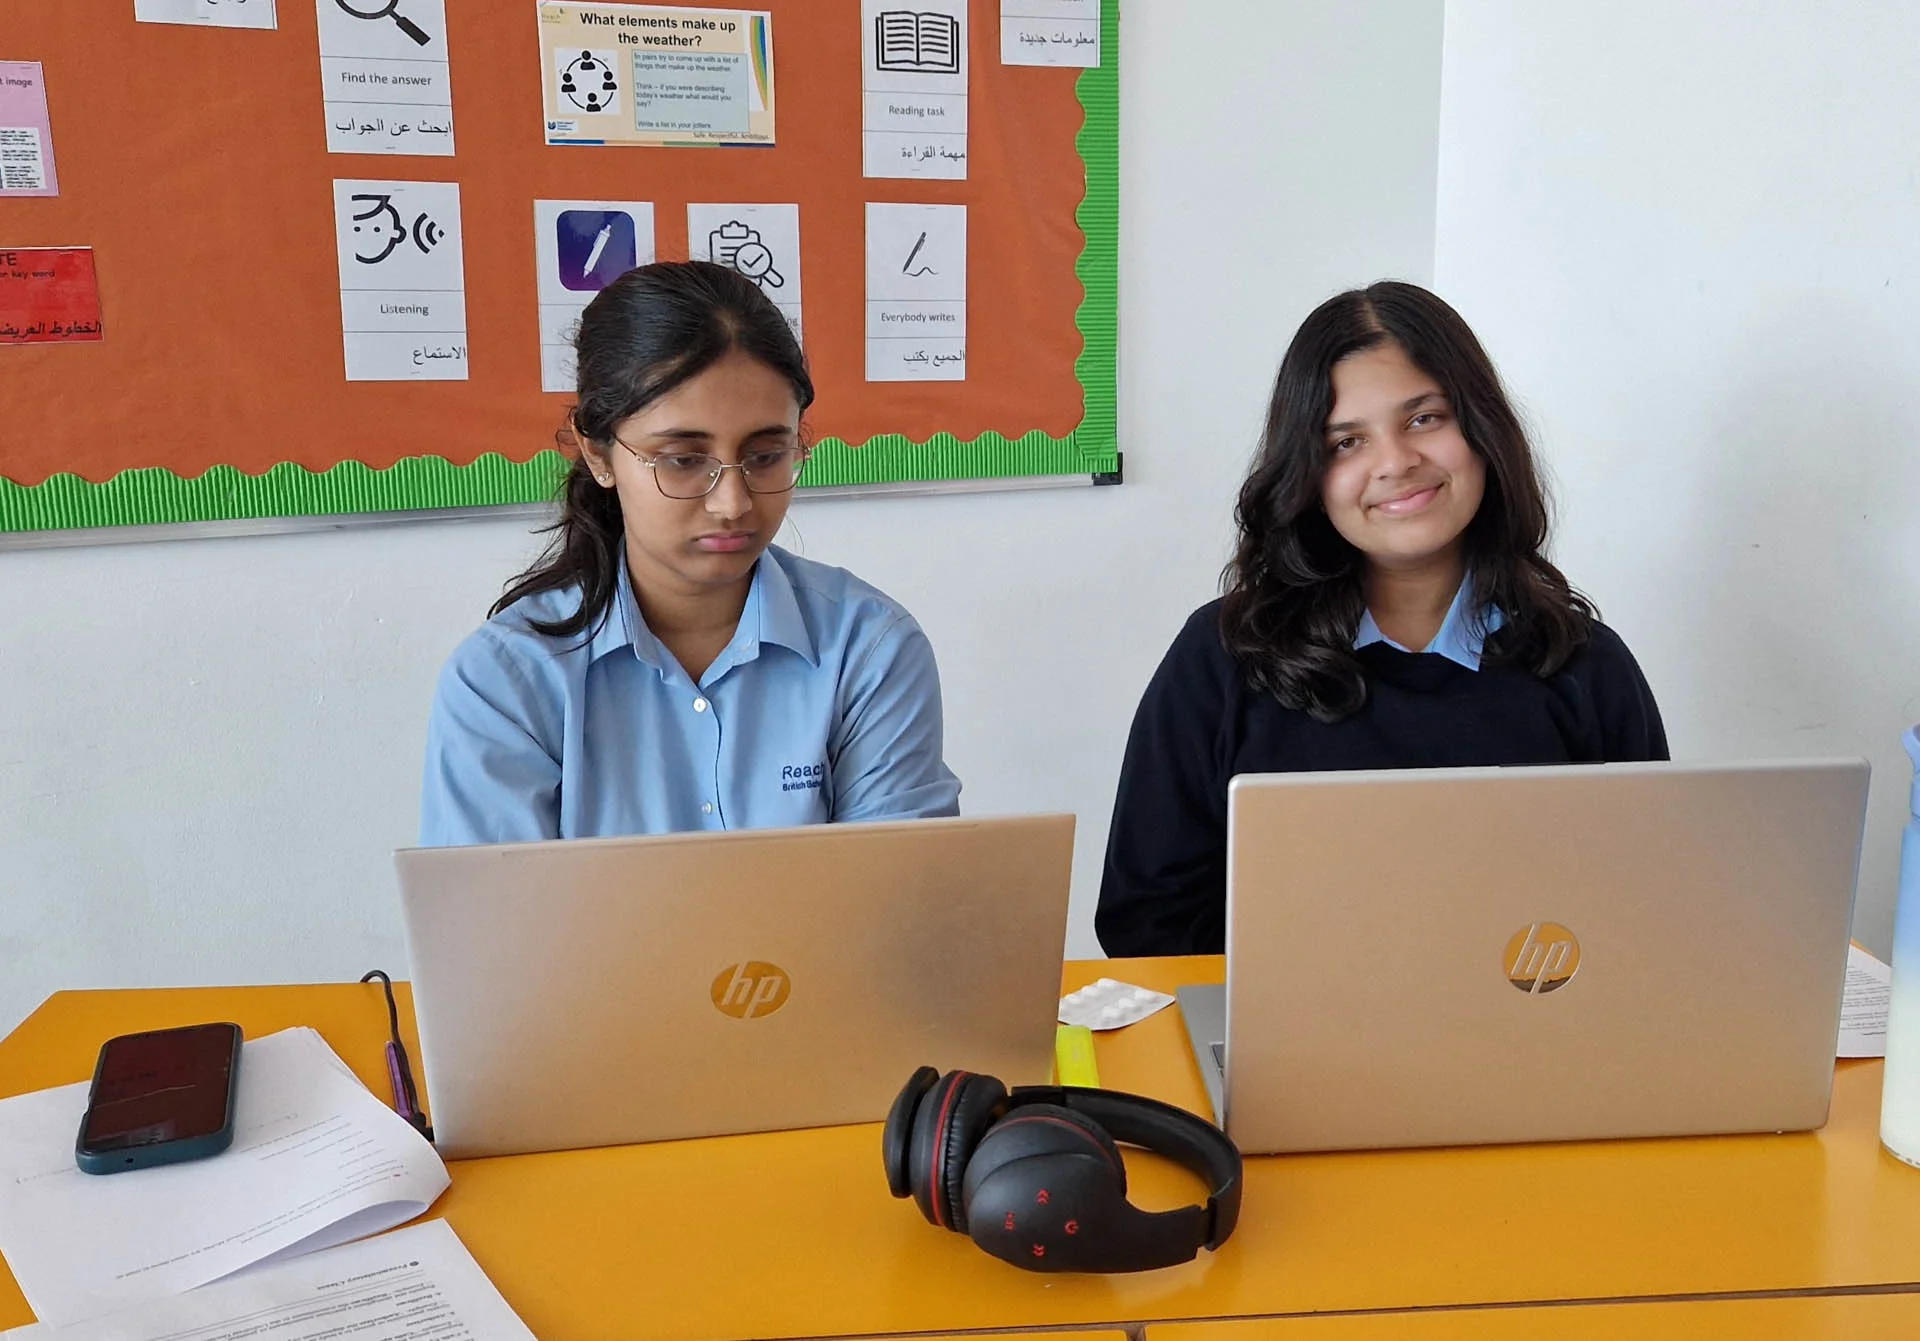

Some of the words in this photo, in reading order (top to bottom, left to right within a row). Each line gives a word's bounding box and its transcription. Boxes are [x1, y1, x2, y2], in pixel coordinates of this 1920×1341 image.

[580, 12, 614, 25] What
[618, 14, 678, 28] elements
[682, 18, 716, 31] make
[720, 21, 736, 34] up
[618, 32, 639, 44] the
[642, 34, 702, 47] weather?
[1019, 32, 1047, 46] جديدة
[1051, 31, 1095, 48] معلومات
[6, 77, 33, 88] image
[341, 72, 366, 84] Find
[369, 72, 388, 84] the
[391, 75, 432, 86] answer
[888, 104, 925, 118] Reading
[927, 106, 945, 116] task
[336, 117, 384, 136] الجواب
[390, 122, 411, 136] عن
[417, 119, 452, 136] ابحث
[901, 145, 936, 162] القراءة
[939, 145, 966, 162] مهمة
[380, 303, 429, 316] Listening
[881, 312, 927, 323] Everybody
[929, 312, 956, 321] writes
[49, 320, 102, 337] الخطوط
[412, 345, 467, 365] الاستماع
[903, 350, 930, 364] يكتب
[932, 349, 965, 367] الجميع
[1510, 920, 1573, 994] hp
[721, 960, 784, 1019] hp
